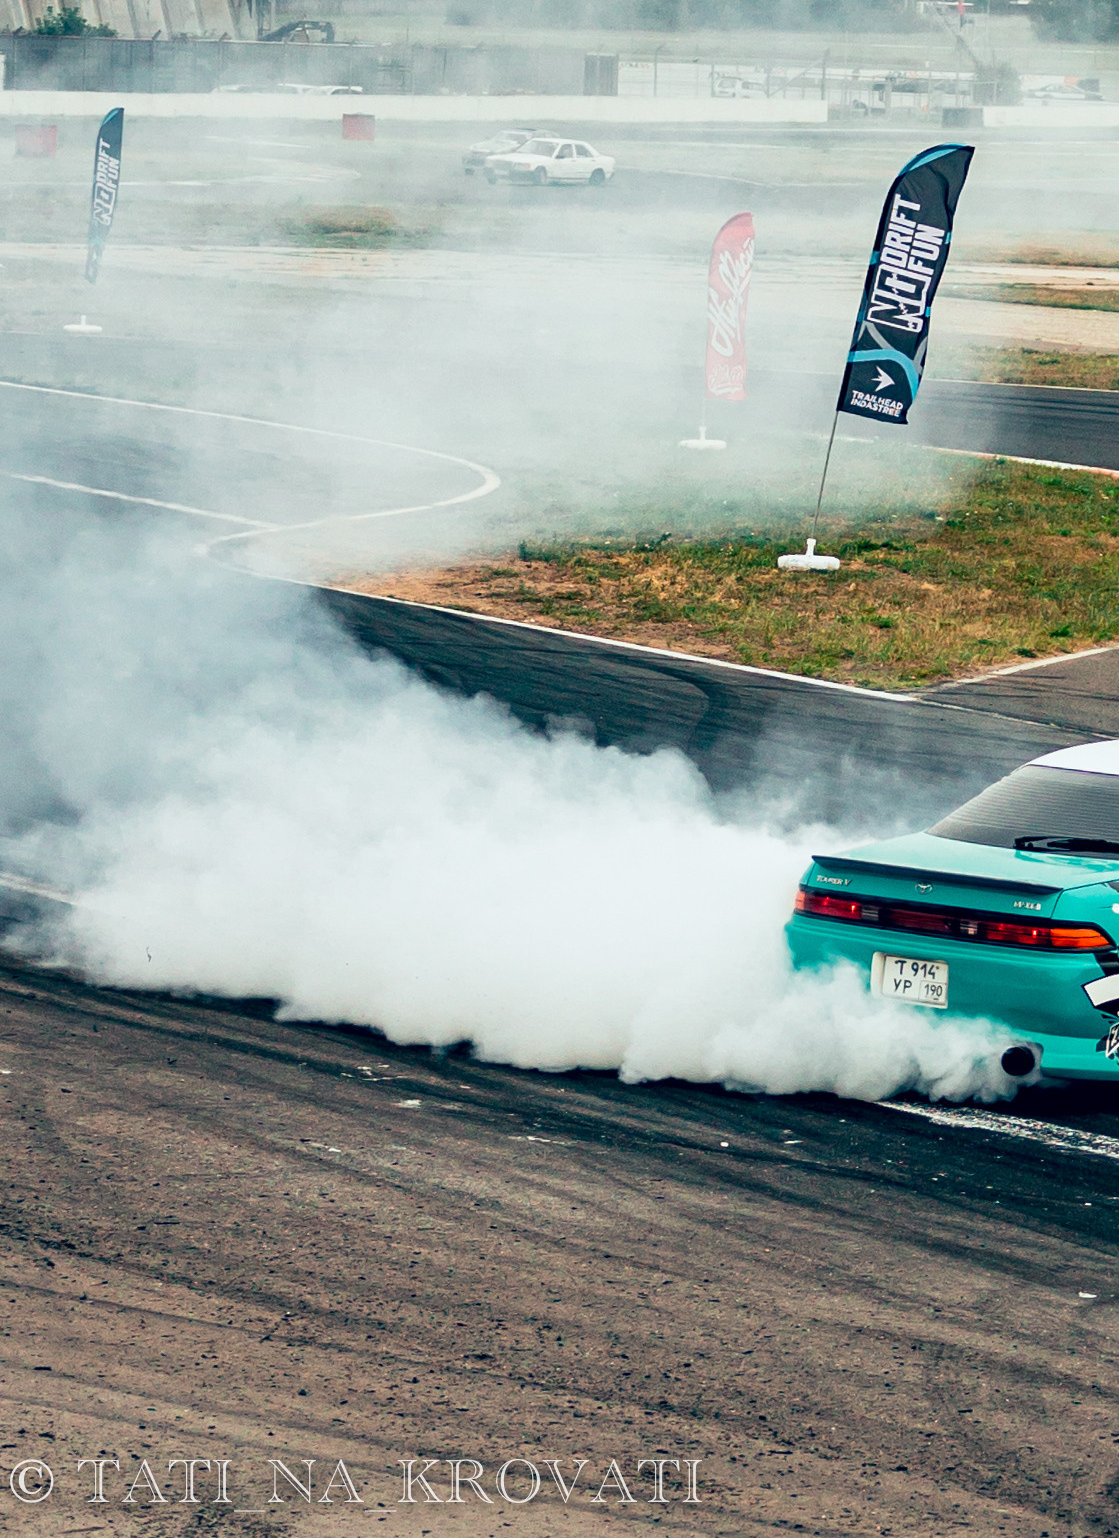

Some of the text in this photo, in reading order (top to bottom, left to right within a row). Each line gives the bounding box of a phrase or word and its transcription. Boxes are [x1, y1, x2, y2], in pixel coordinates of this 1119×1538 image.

[96, 138, 111, 186] DRIFT
[107, 157, 120, 189] FUN
[880, 193, 921, 270] DRIFT
[907, 224, 946, 276] FUN
[911, 961, 937, 980] 914
[924, 983, 943, 998] 190
